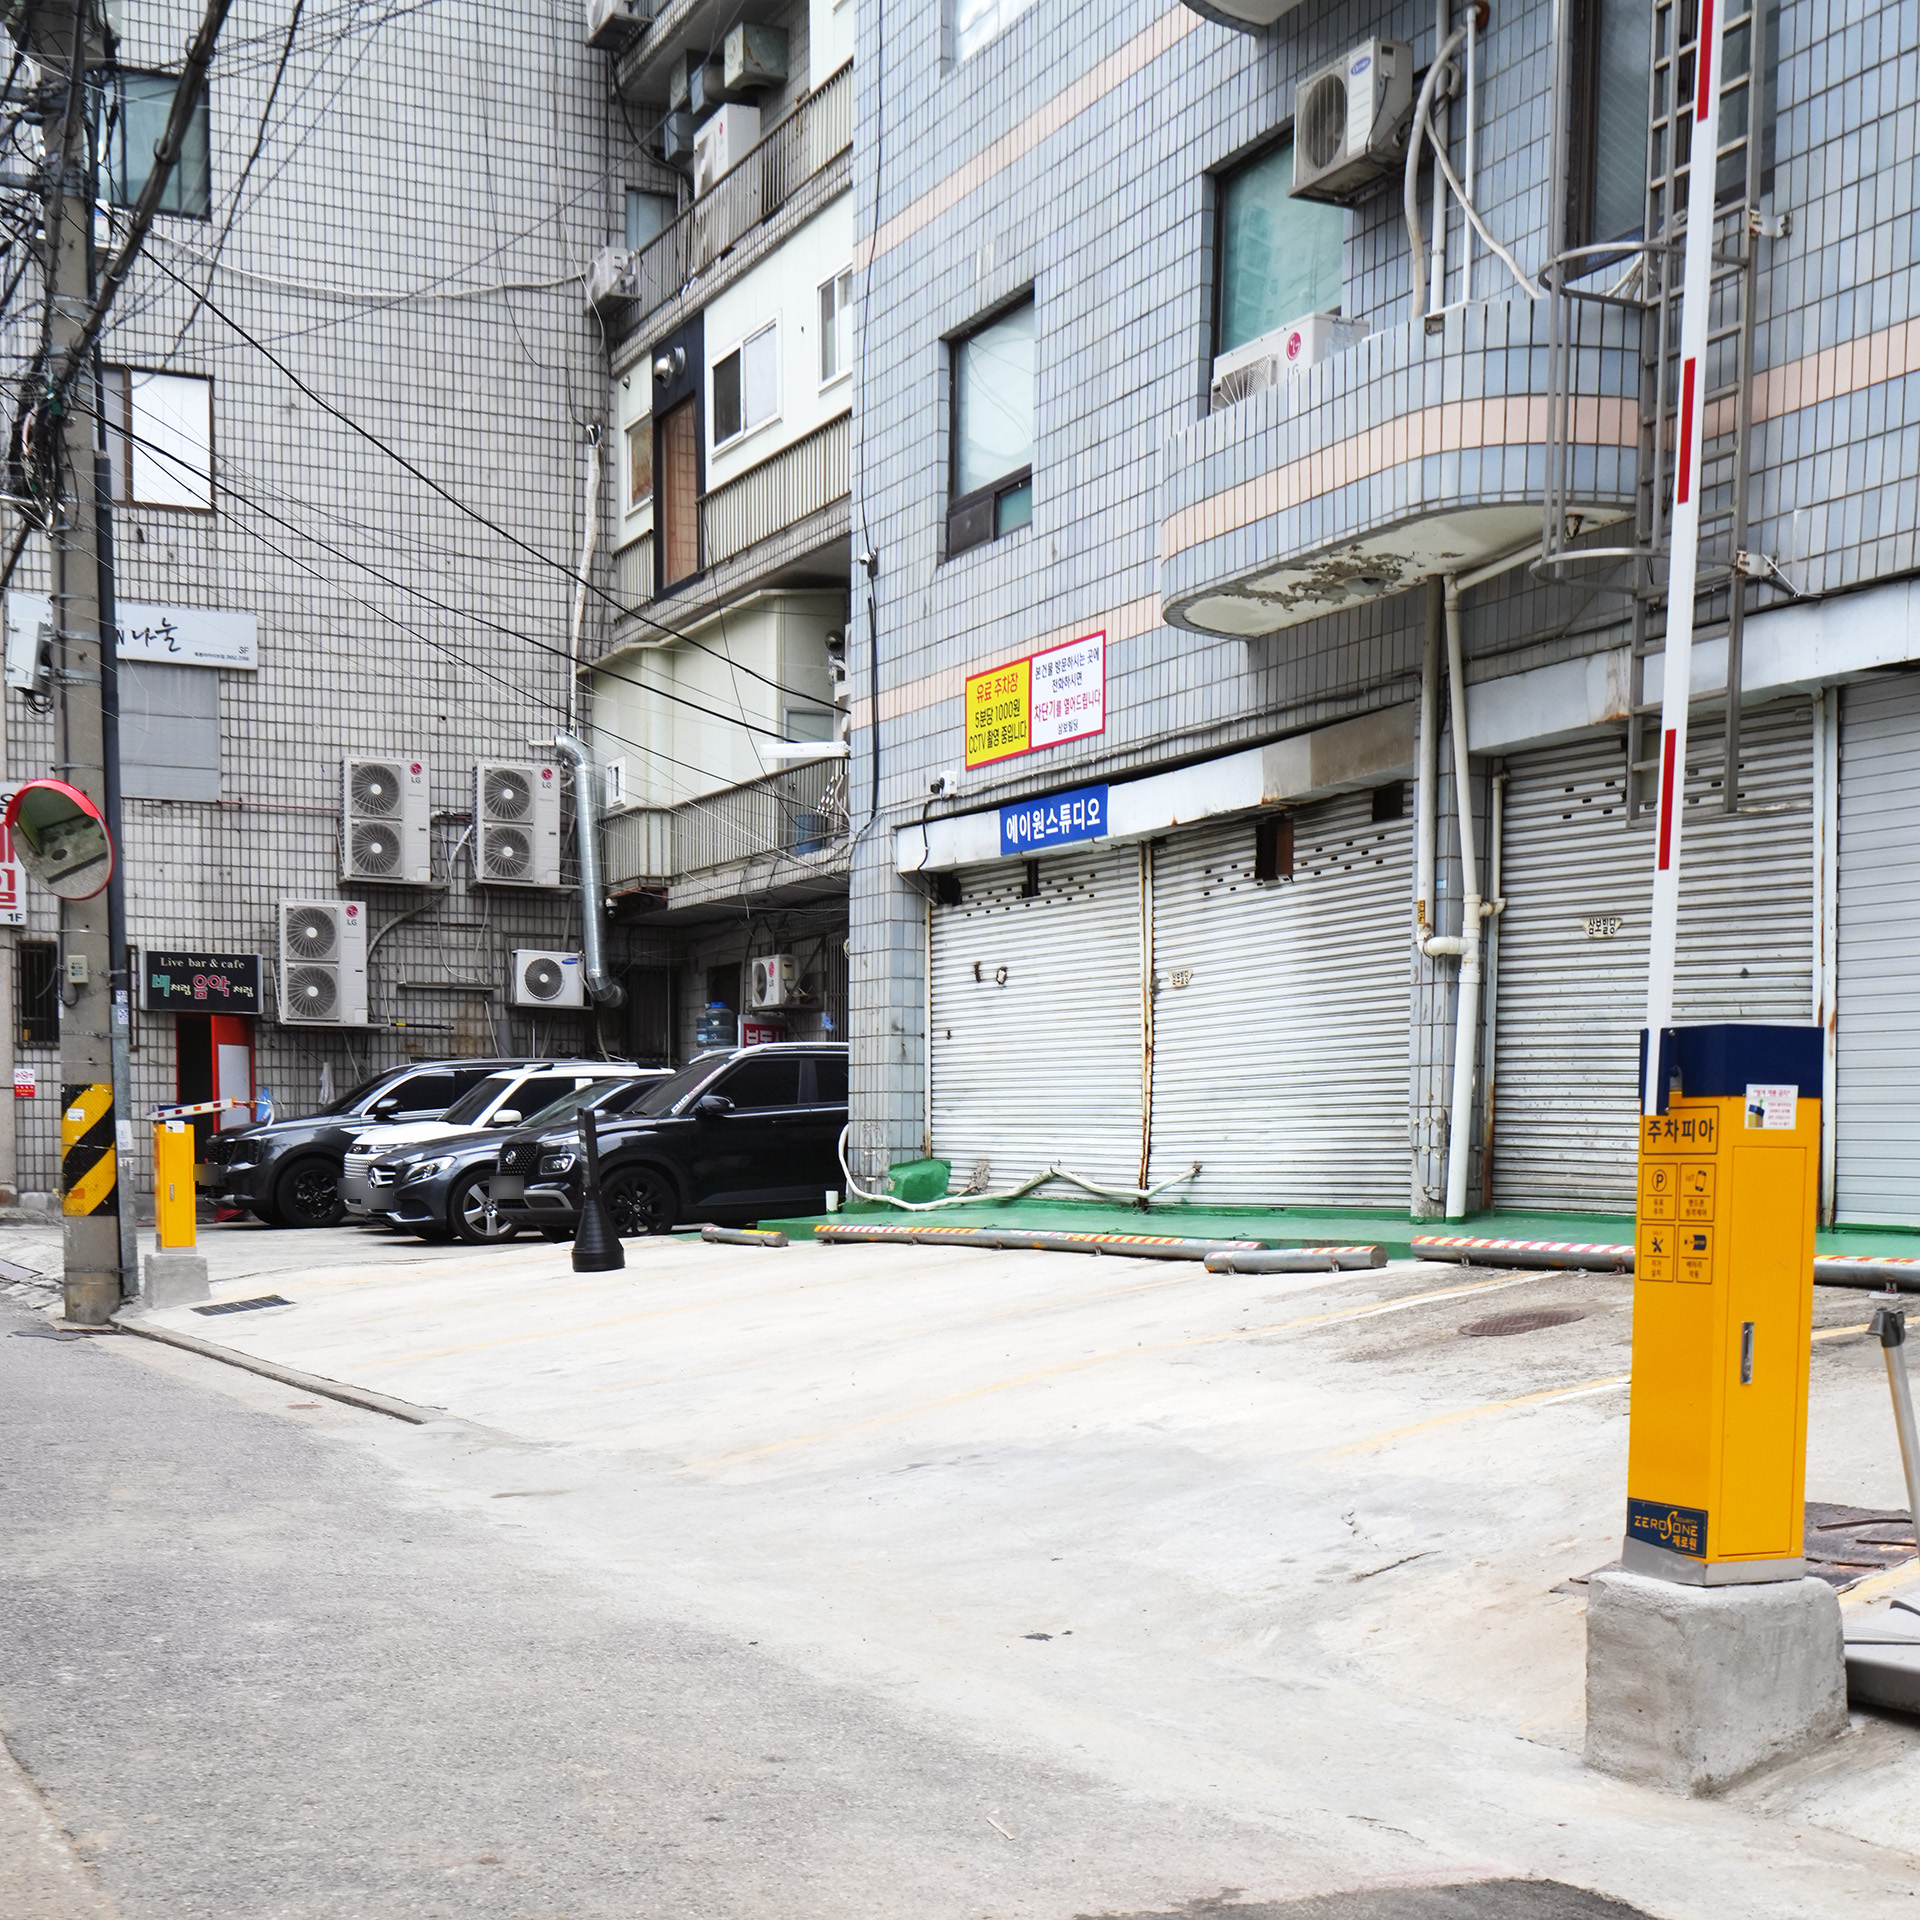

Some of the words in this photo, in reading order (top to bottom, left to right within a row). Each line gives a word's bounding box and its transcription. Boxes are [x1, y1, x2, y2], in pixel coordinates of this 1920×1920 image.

[1054, 652, 1085, 675] 방문하시는
[1086, 647, 1100, 664] 곳에
[976, 681, 992, 704] 유료
[994, 672, 1019, 698] 주차장
[1052, 671, 1082, 693] 전화하시면
[975, 706, 994, 729] 5분당
[995, 698, 1020, 722] 1000원
[1034, 699, 1062, 722] 차단기를
[1063, 688, 1101, 715] 열어드립니다
[969, 733, 986, 754] CCTV
[987, 728, 999, 749] 촬영
[1001, 719, 1027, 745] 중입니다
[411, 776, 421, 784] LG
[1006, 798, 1101, 844] 에이원스튜디오
[8, 912, 23, 923] 1F
[1588, 917, 1616, 935] 삼보빌딩
[160, 957, 184, 967] Live
[188, 957, 207, 968] bar
[209, 958, 218, 968] &
[221, 960, 246, 969] cafe
[1647, 1117, 1714, 1143] 주차피아
[1656, 1173, 1664, 1188] P
[1672, 1535, 1697, 1551] 제로원
